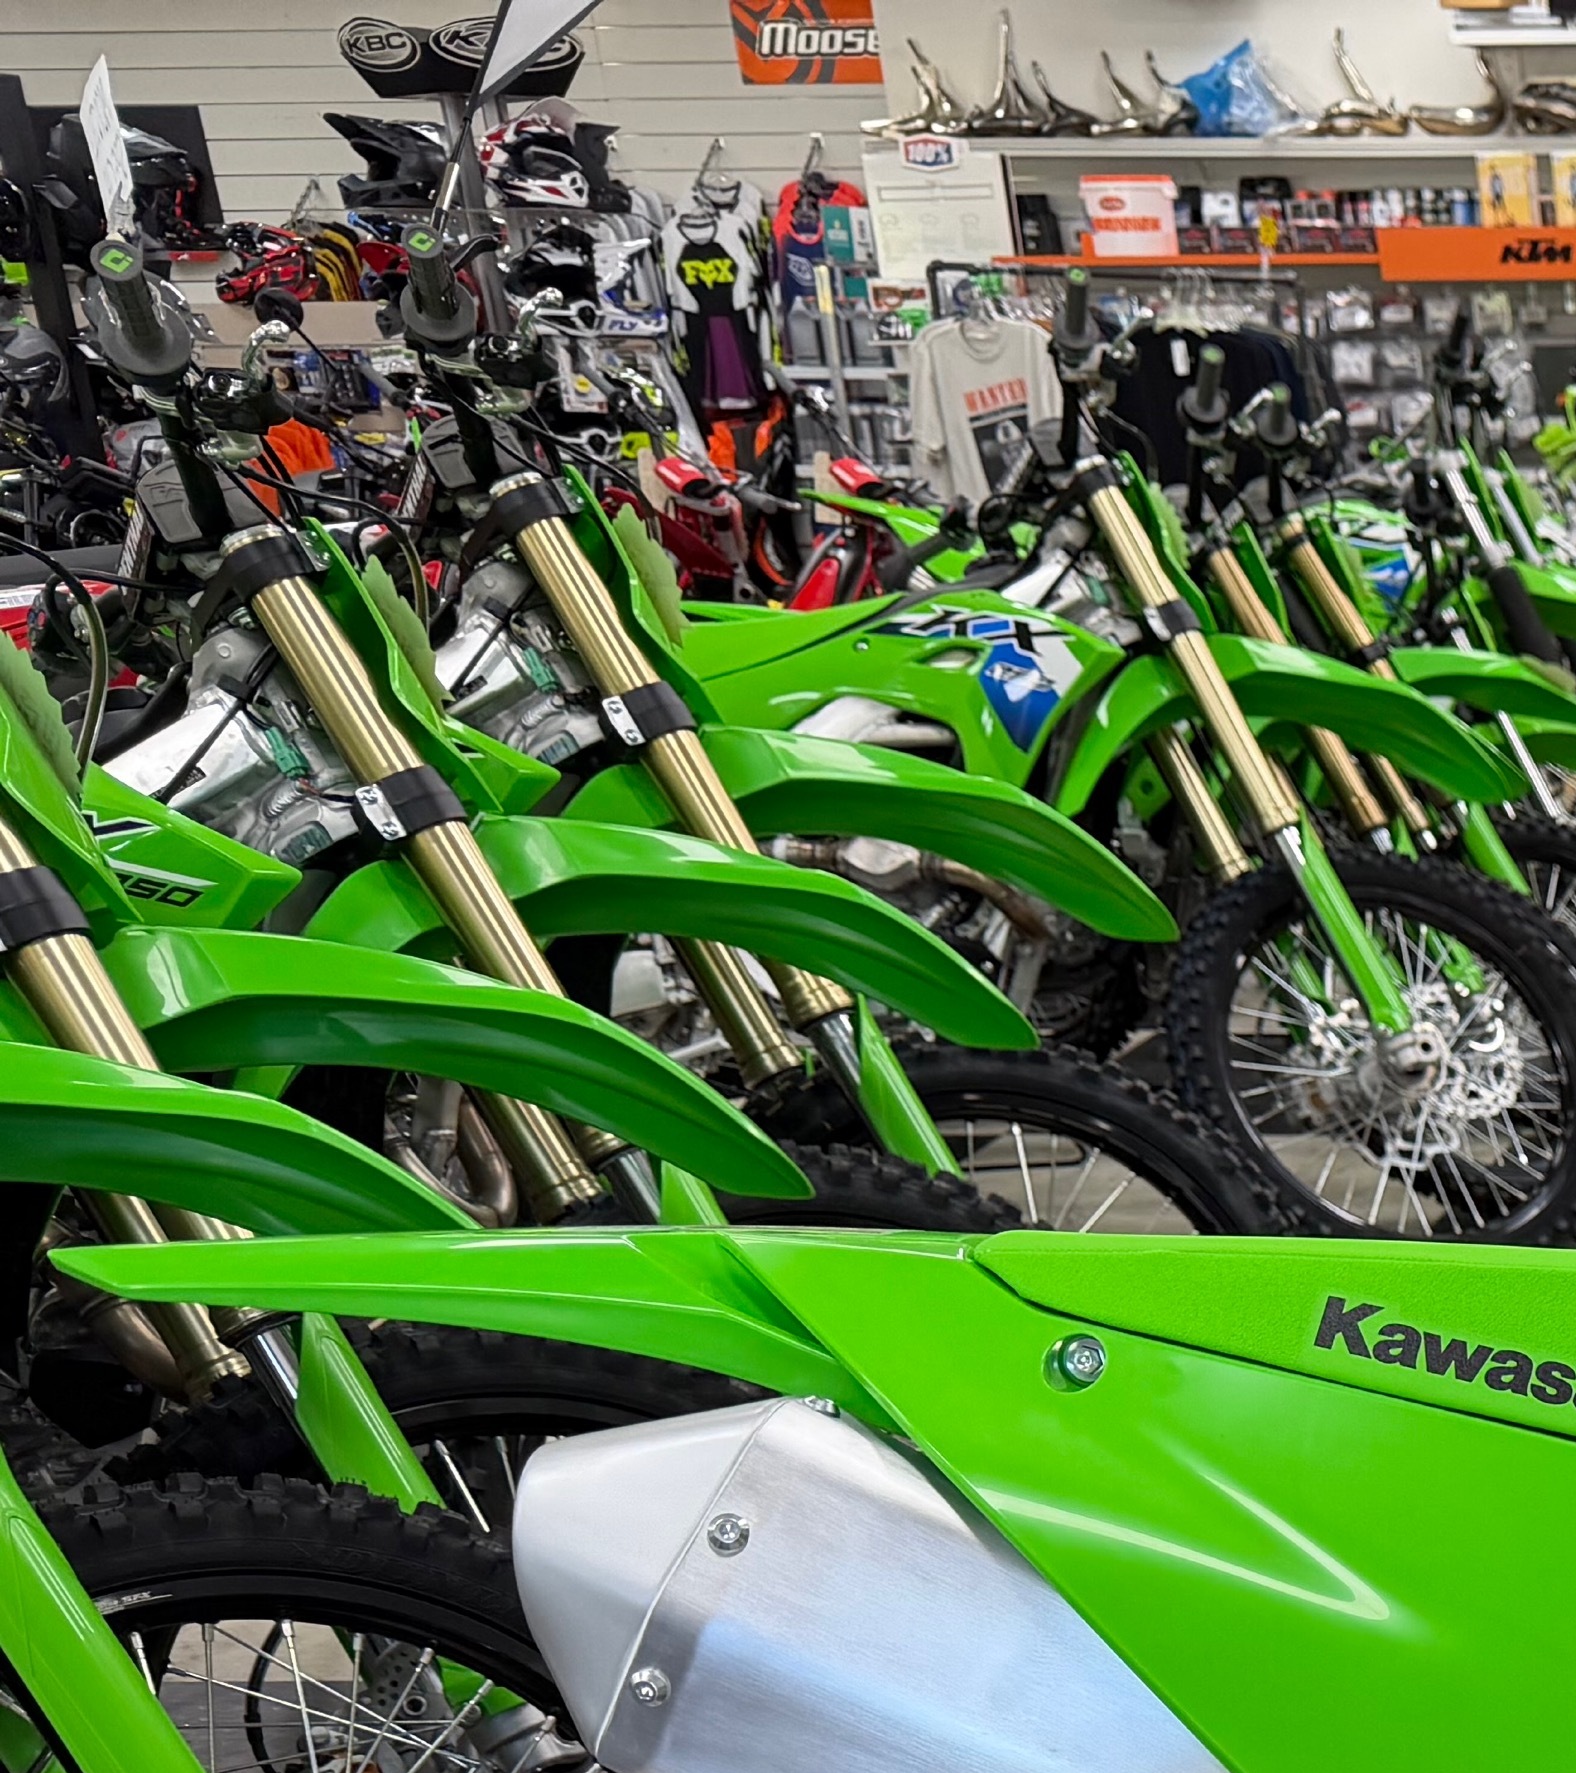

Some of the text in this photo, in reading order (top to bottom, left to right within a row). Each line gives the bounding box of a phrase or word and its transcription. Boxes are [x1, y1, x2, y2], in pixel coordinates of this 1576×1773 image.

[346, 31, 407, 53] KBC
[1501, 237, 1573, 264] KTM
[116, 872, 205, 908] 50
